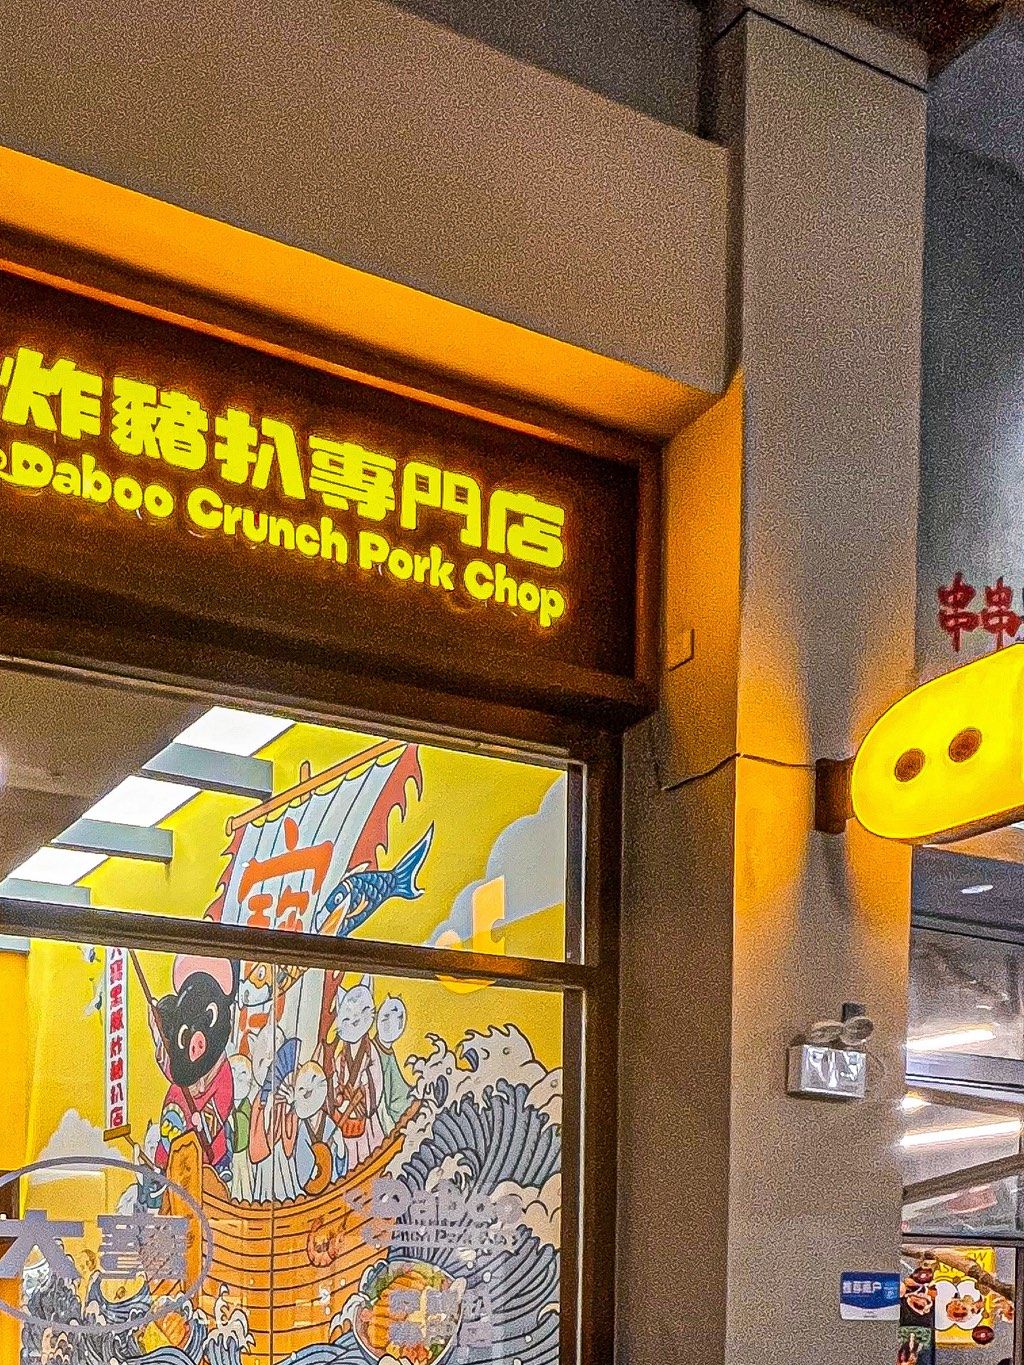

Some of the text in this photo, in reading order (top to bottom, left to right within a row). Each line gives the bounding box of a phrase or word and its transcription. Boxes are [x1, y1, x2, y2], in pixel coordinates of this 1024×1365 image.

[8, 440, 566, 628] Daboo Crunch Pork Chop
